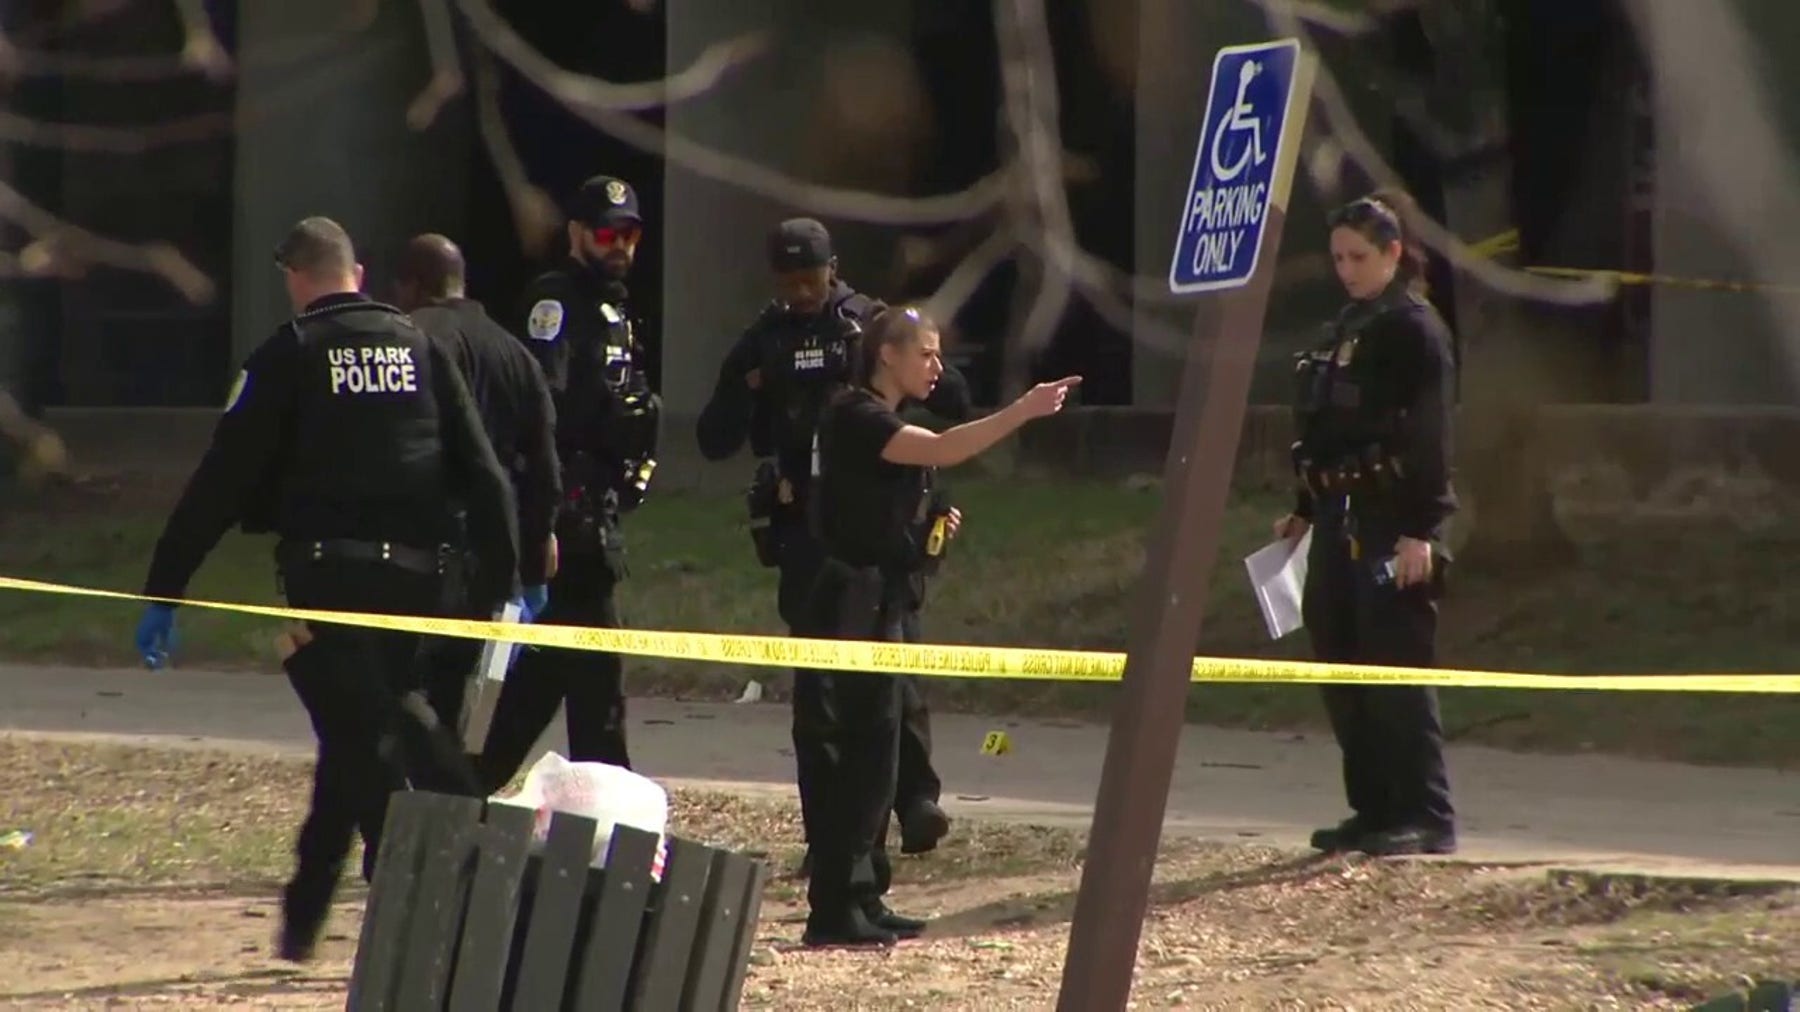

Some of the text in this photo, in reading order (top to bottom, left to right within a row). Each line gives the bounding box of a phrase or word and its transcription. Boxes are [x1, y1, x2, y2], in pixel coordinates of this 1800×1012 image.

[1189, 183, 1264, 230] PARKING
[1193, 229, 1245, 275] ONLY
[328, 346, 413, 366] US PARK
[794, 349, 823, 359] US PARK
[795, 358, 824, 369] POLICE
[331, 365, 416, 394] POLICE
[986, 734, 998, 751] 3
